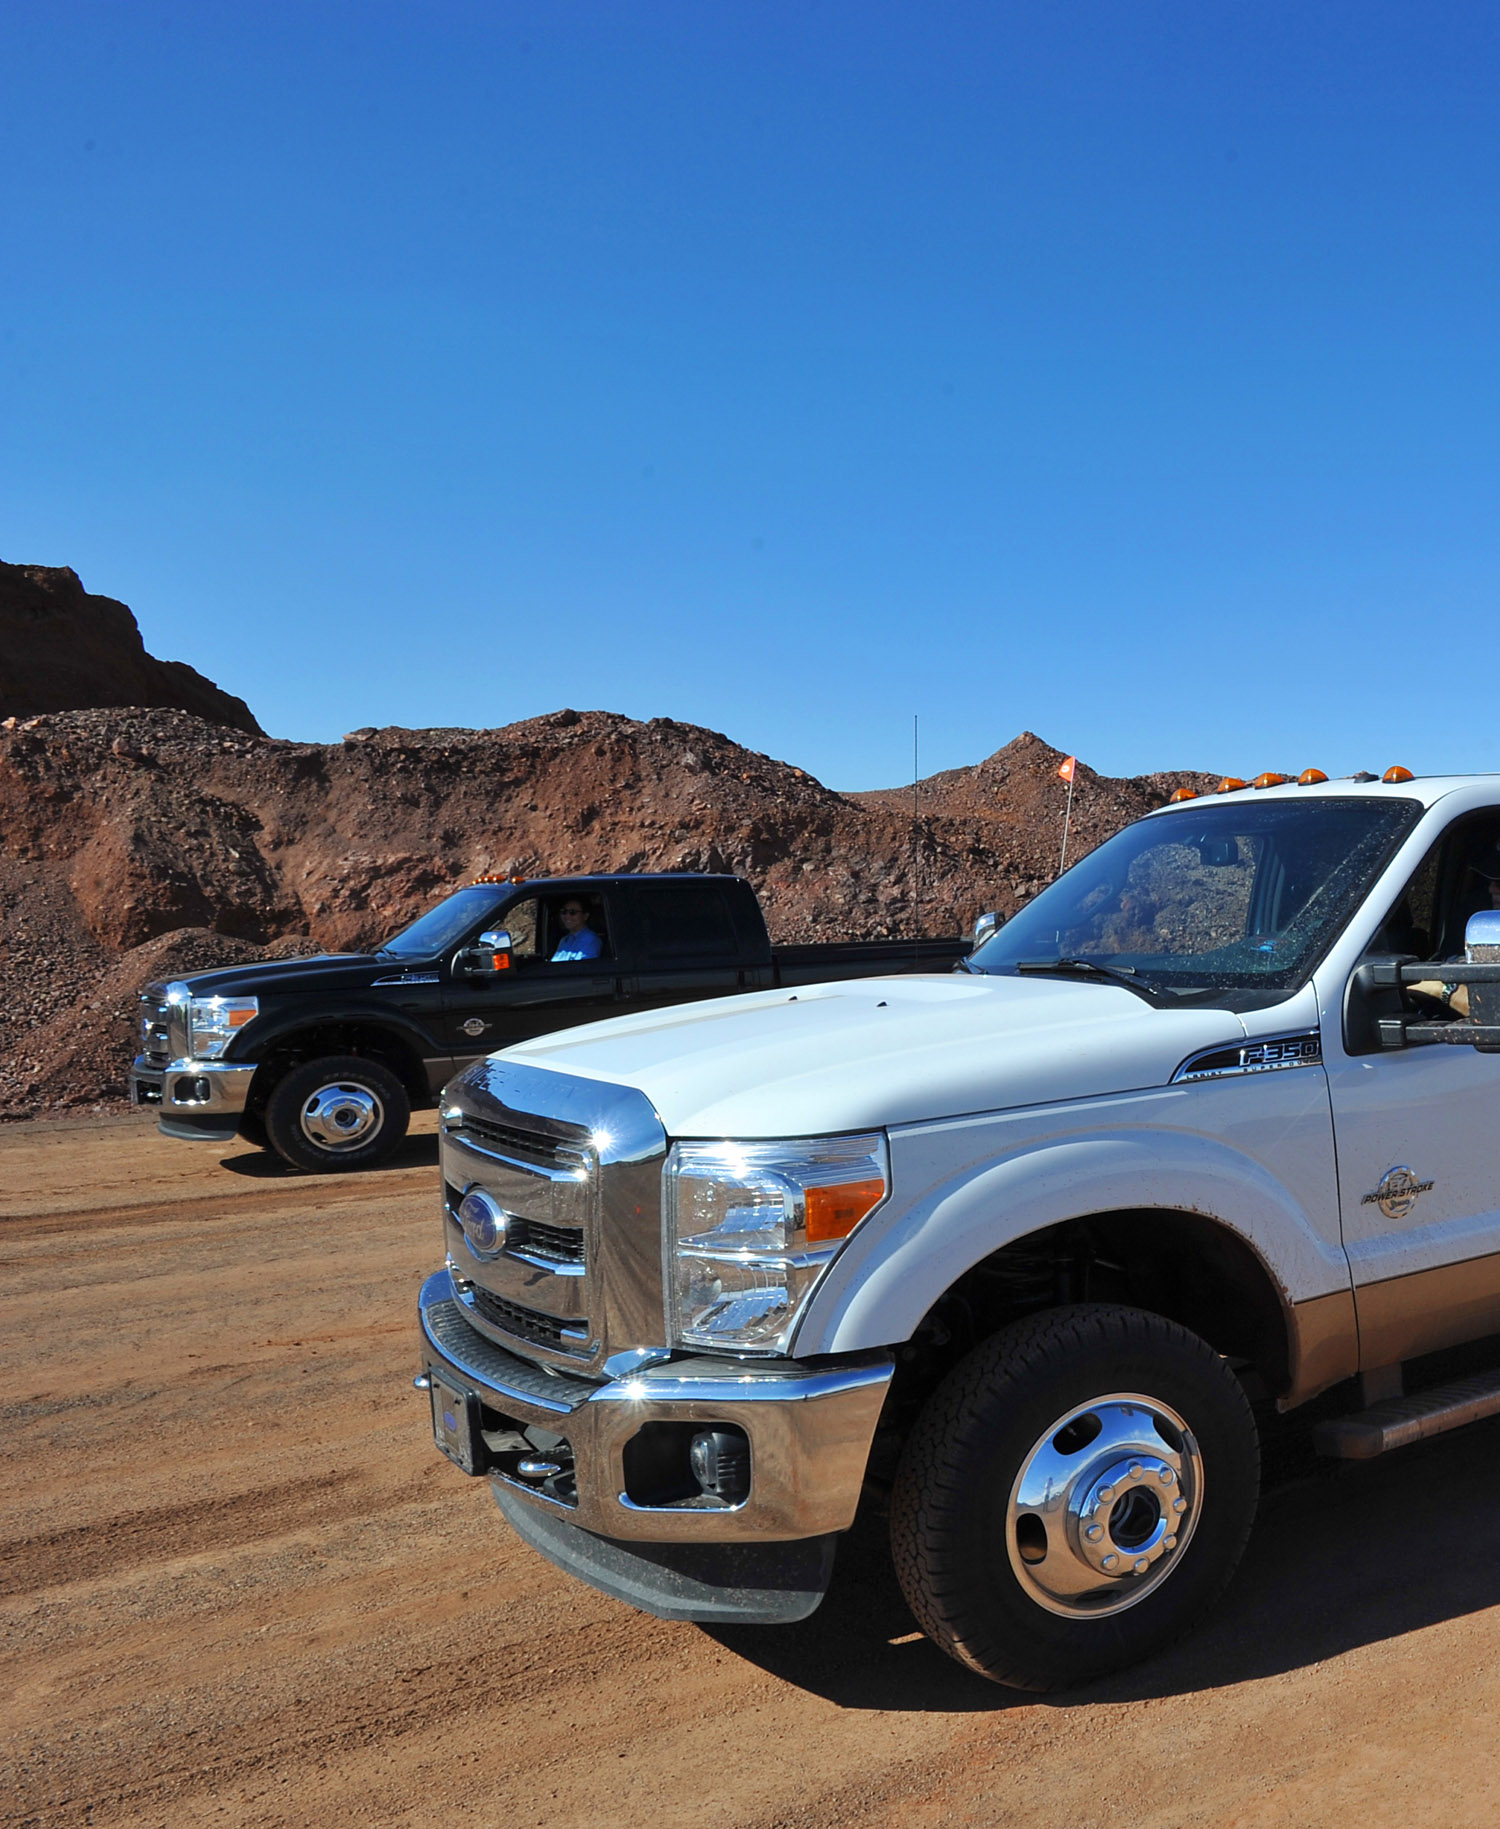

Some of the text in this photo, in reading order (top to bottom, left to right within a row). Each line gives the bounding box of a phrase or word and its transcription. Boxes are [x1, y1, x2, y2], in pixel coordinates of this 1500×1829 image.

[1239, 1040, 1319, 1067] F-350
[1363, 1190, 1399, 1205] POWER
[1398, 1181, 1435, 1198] STROKE
